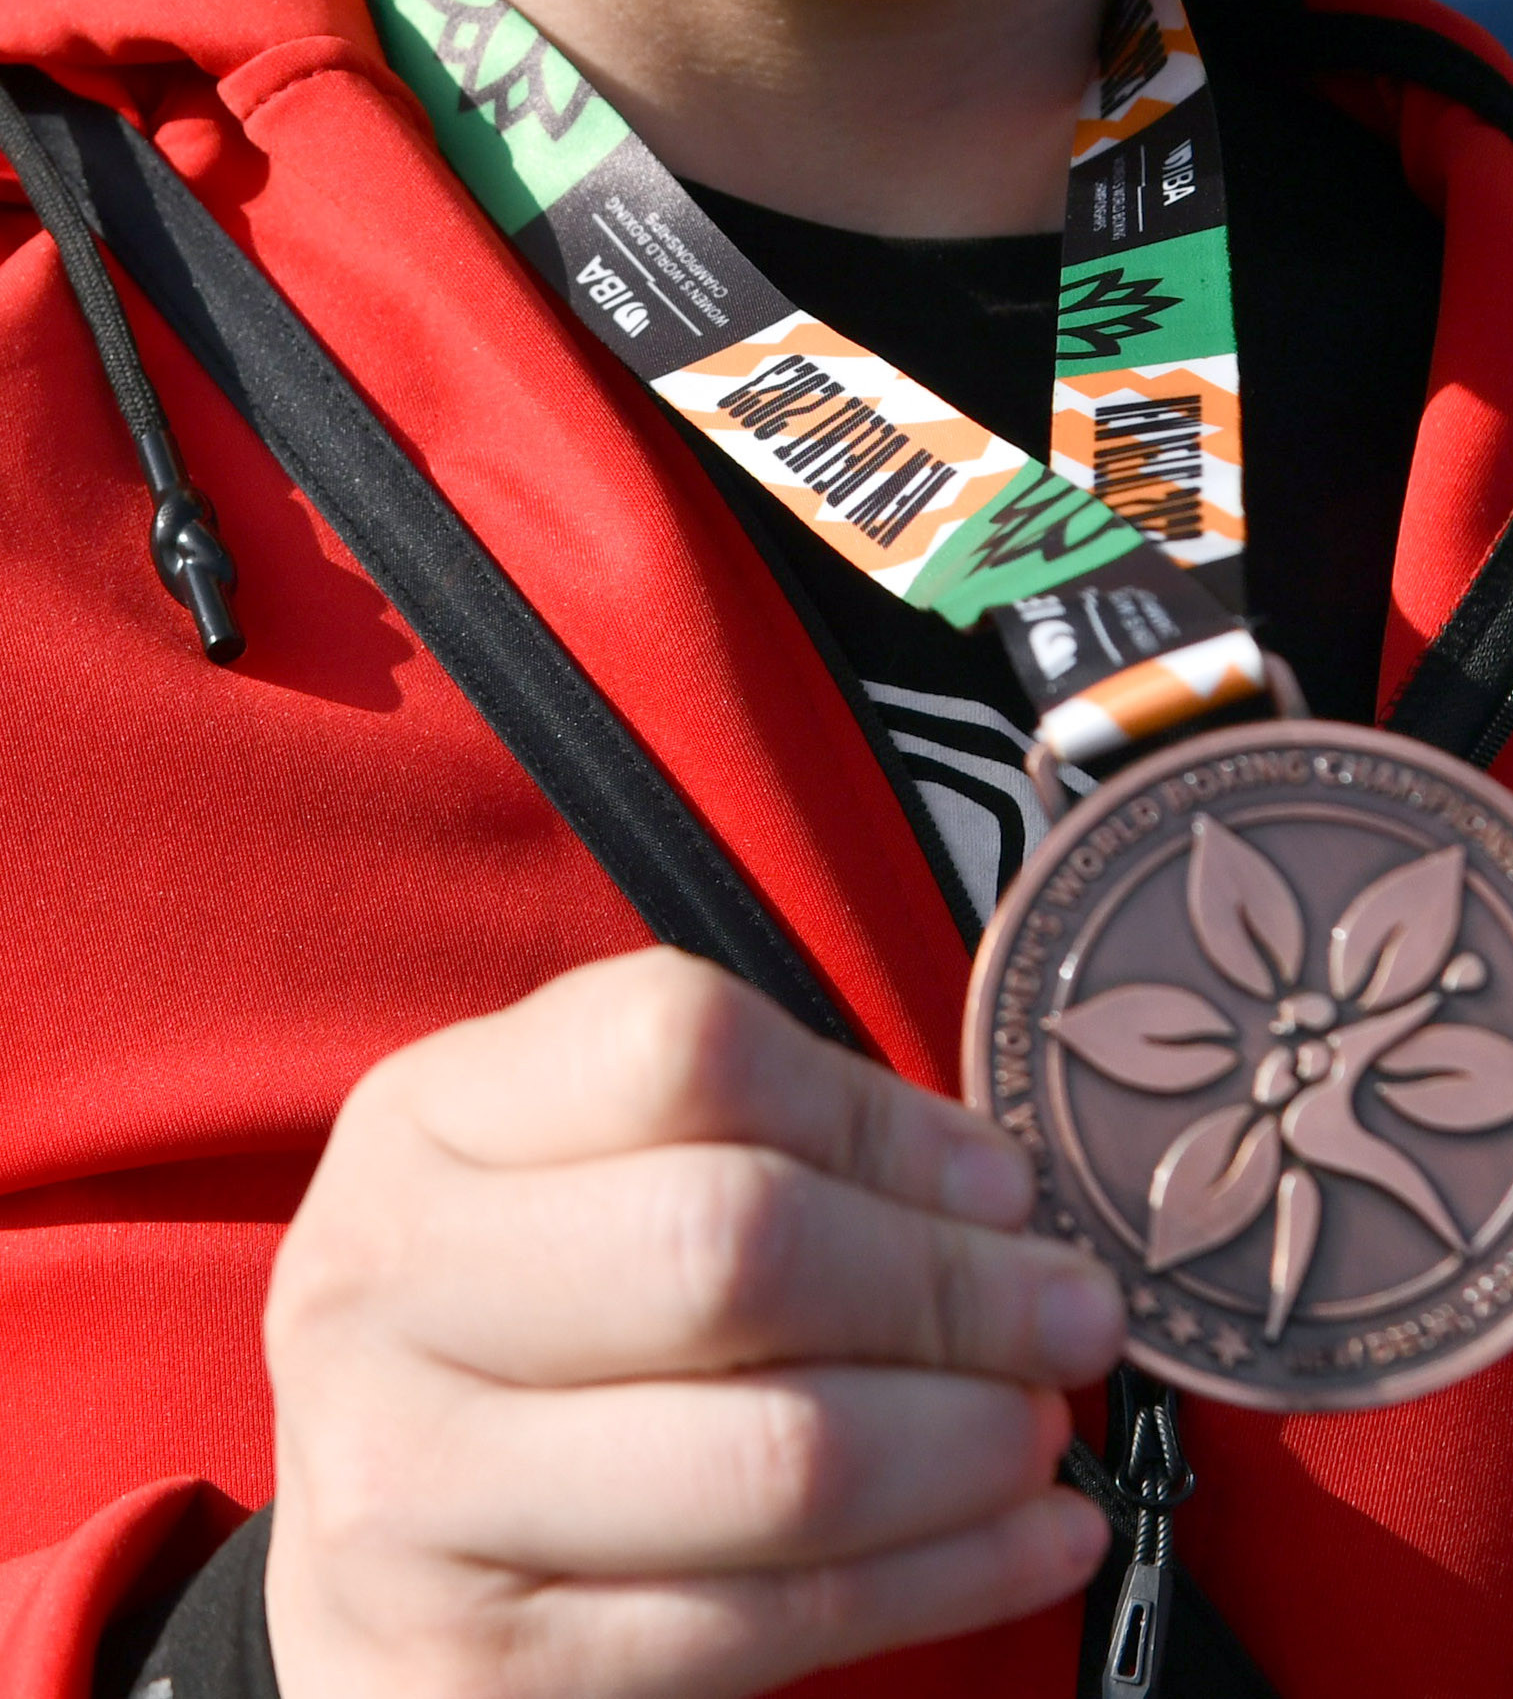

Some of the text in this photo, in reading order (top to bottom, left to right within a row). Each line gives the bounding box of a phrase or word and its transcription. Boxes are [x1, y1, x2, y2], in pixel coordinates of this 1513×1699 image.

[1162, 164, 1196, 207] IBA
[604, 196, 651, 247] BOXING
[575, 254, 634, 311] IBA
[644, 211, 729, 299] CHAMPIONSHIPS
[645, 242, 686, 284] WORLD
[716, 354, 958, 550] NEW DELHI 2023
[1043, 796, 1162, 908] WORLD
